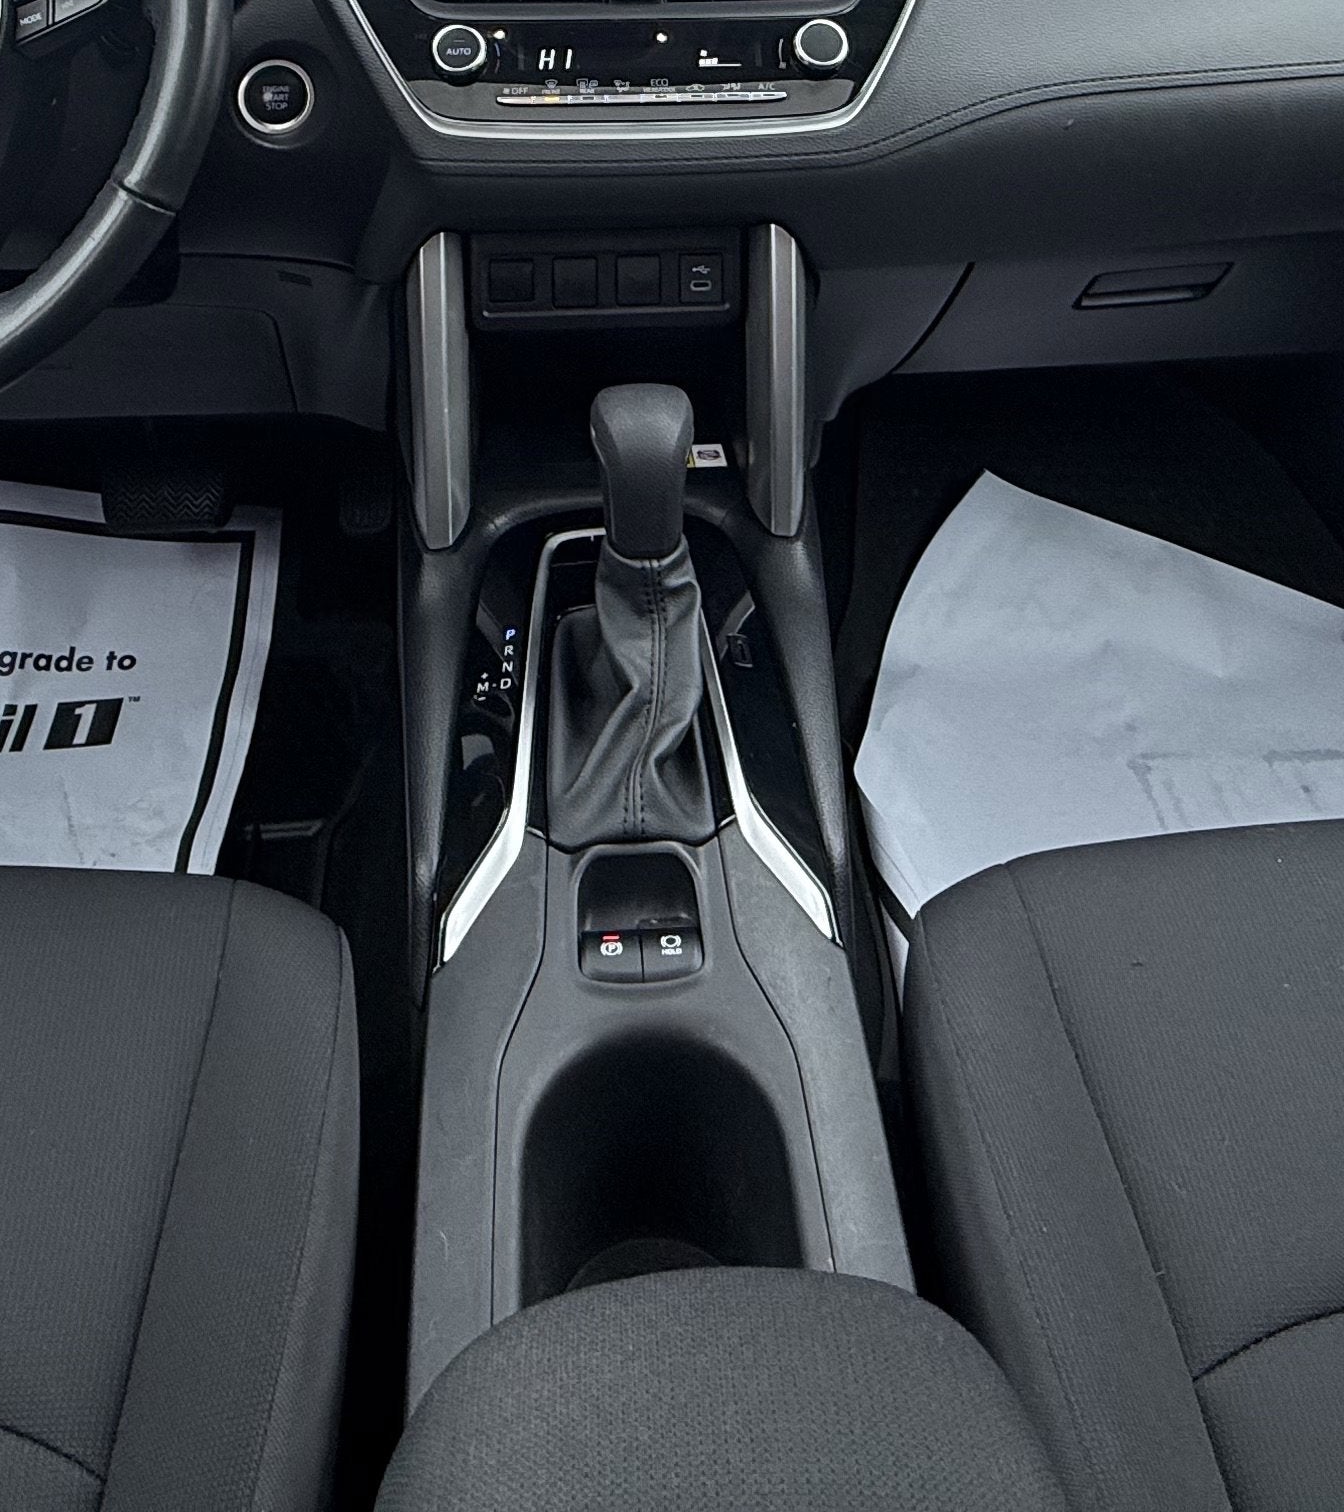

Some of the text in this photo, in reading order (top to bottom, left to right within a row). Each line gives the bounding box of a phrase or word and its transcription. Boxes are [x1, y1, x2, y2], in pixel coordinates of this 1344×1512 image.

[19, 12, 42, 26] MODE
[446, 47, 471, 56] AUTO
[650, 78, 668, 87] ECO
[511, 87, 528, 95] OFF
[266, 102, 288, 111] STOP
[506, 629, 516, 640] P
[504, 645, 514, 656] R
[106, 651, 137, 671] to
[502, 661, 513, 673] N
[477, 678, 511, 693] M D
